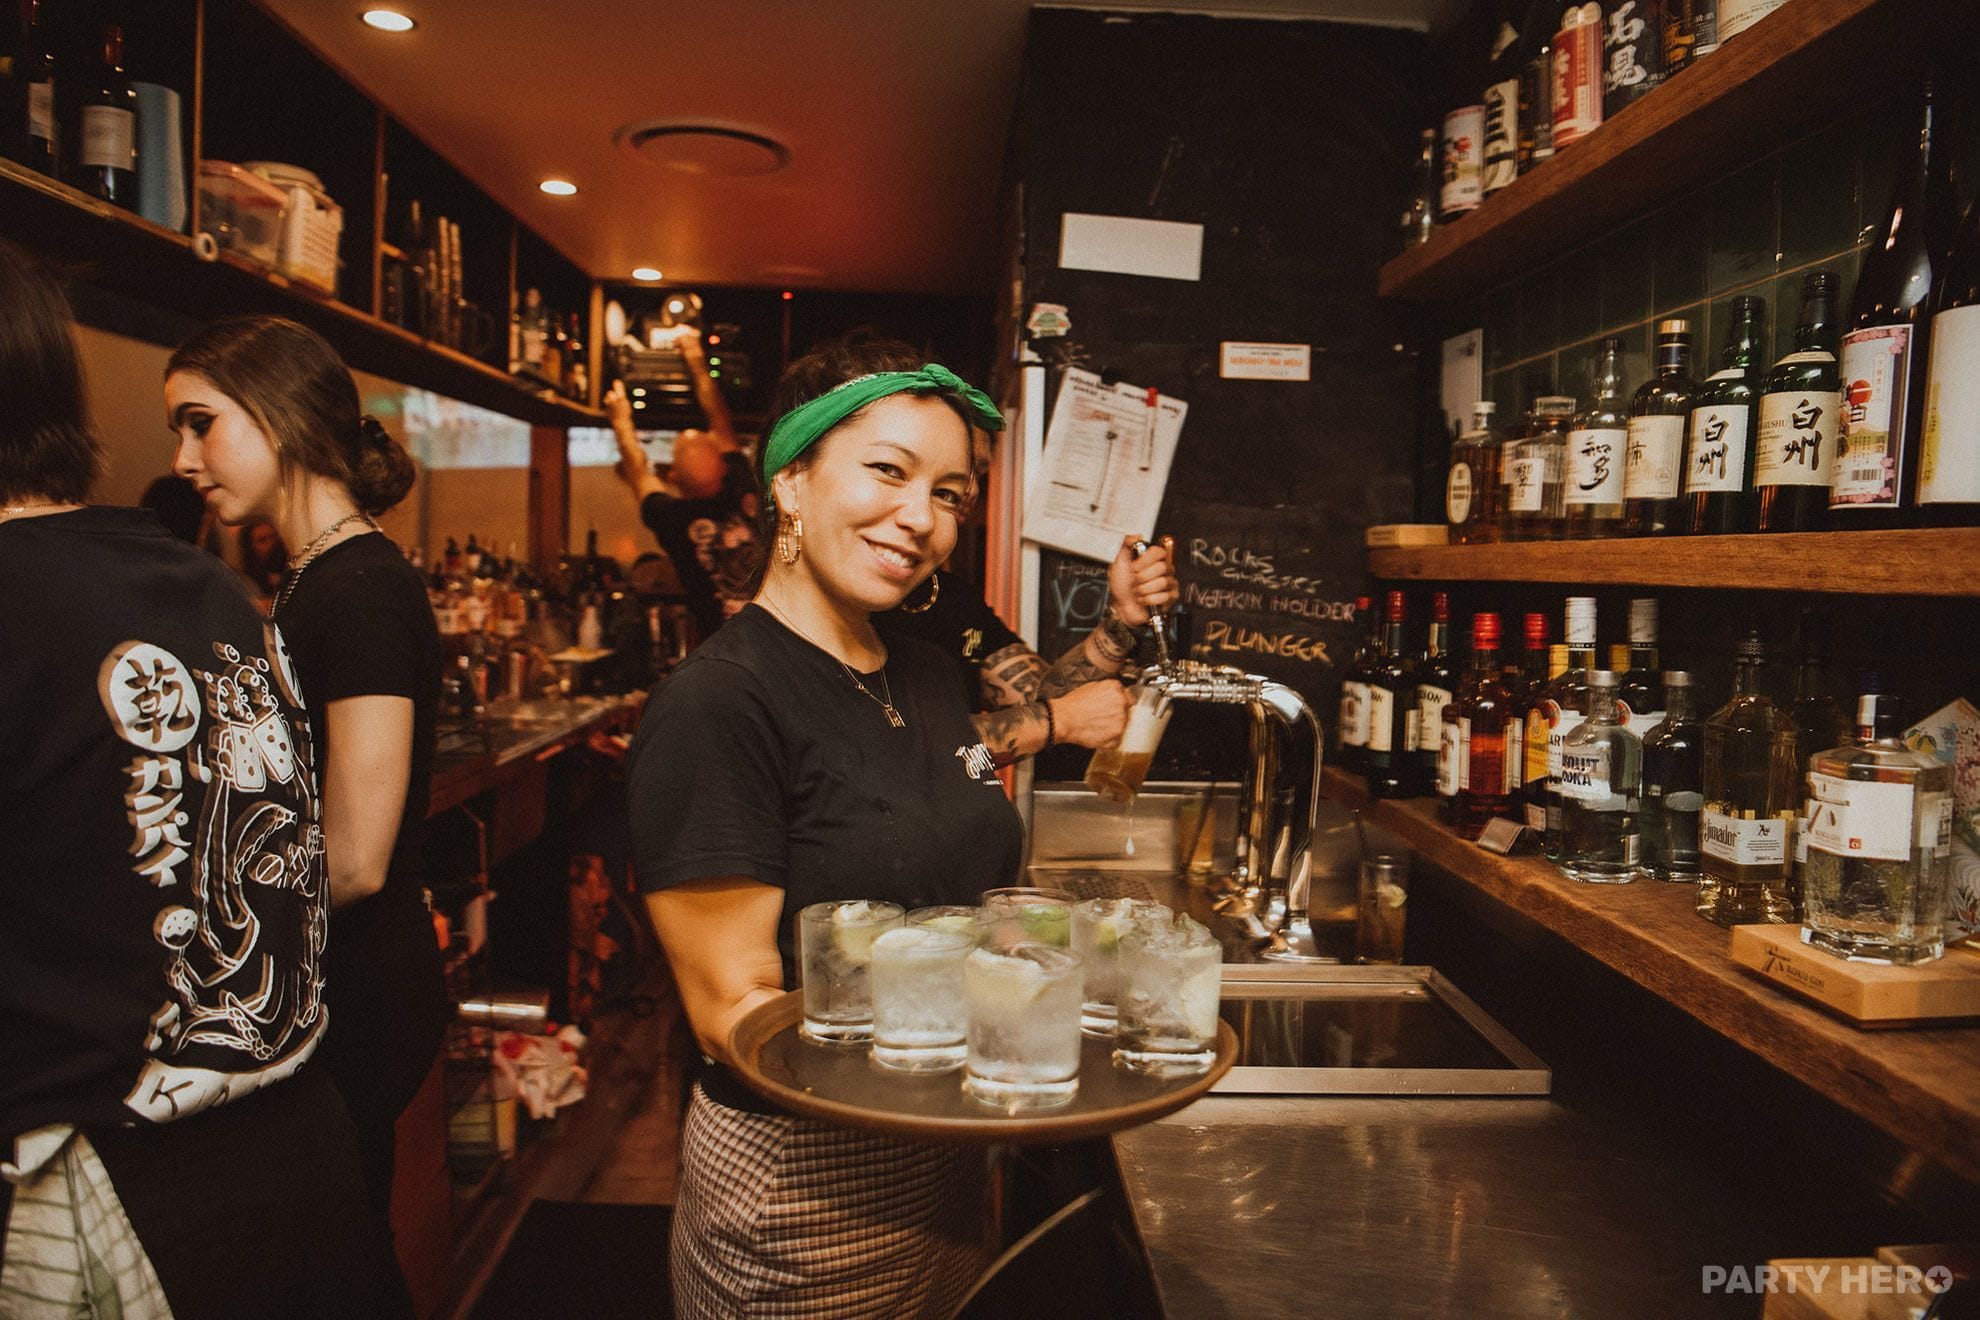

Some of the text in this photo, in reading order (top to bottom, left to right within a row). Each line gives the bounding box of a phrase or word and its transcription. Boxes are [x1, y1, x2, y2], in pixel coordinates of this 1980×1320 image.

[1579, 434, 1613, 491] 知多
[1629, 440, 1647, 467] 市
[1696, 414, 1730, 480] 白州
[1783, 398, 1824, 471] 白州
